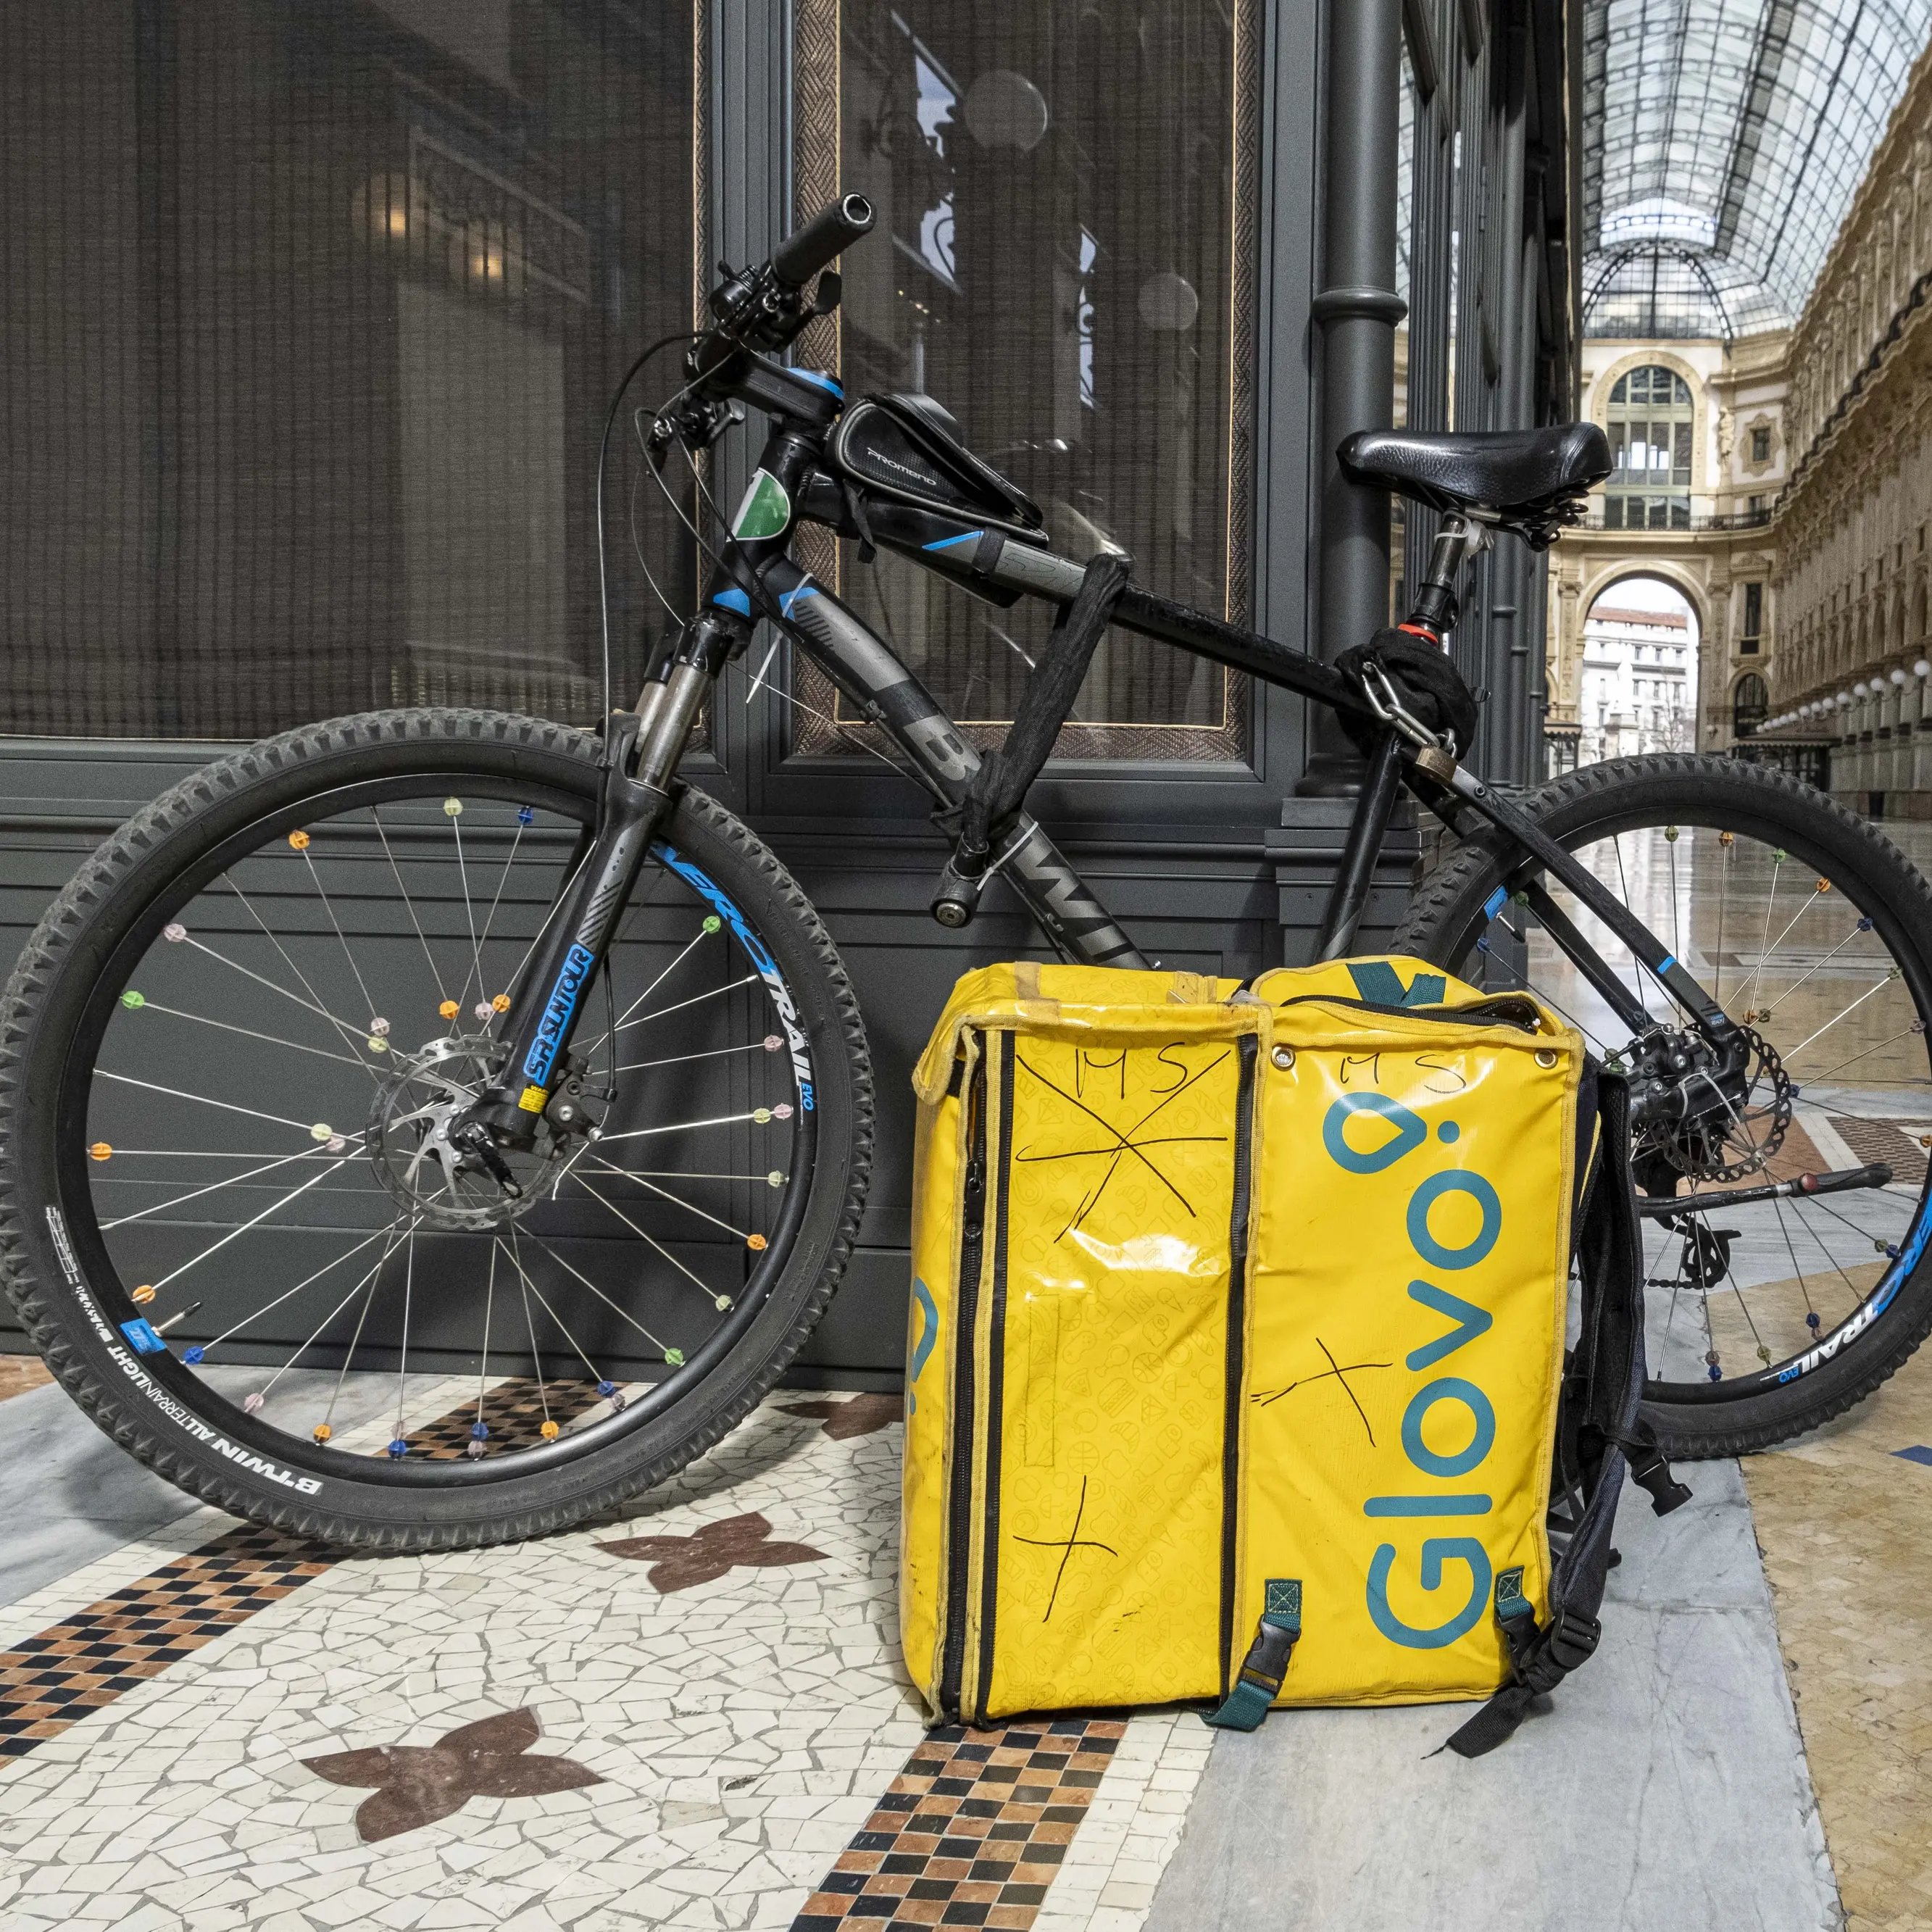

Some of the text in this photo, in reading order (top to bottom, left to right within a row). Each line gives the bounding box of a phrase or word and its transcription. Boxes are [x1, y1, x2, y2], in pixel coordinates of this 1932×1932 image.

[526, 1038, 554, 1080] SR
[542, 948, 589, 1043] SUNTOUR
[801, 1083, 814, 1111] EVO
[1364, 1169, 1502, 1649] Glovo
